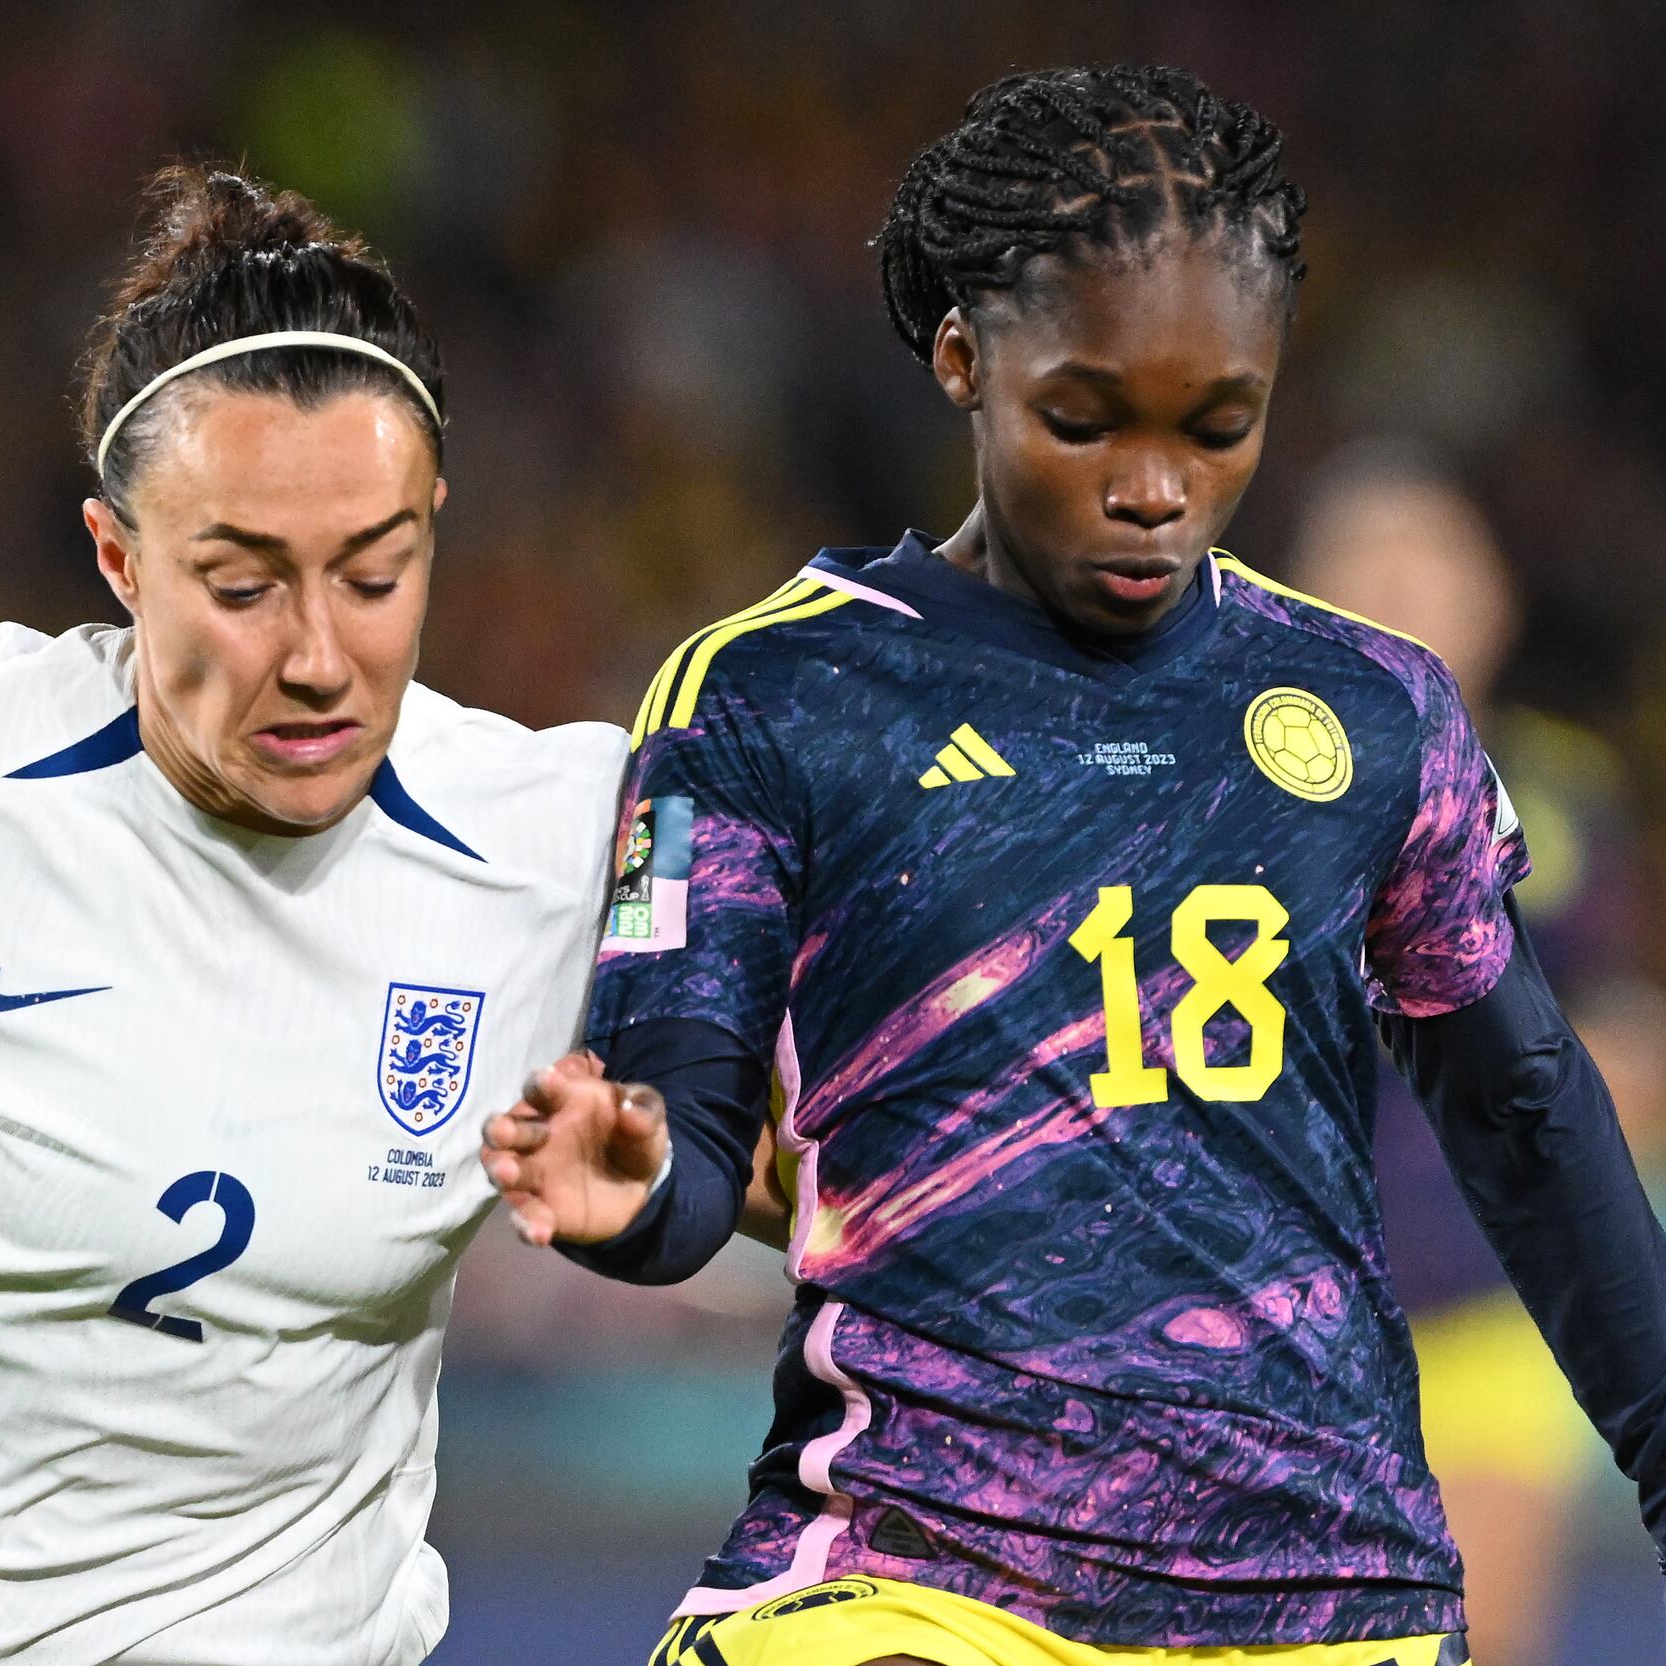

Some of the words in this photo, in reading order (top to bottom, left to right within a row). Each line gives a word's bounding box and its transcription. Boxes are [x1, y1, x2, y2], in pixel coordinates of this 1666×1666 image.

[1094, 742, 1148, 754] ENGLAND
[1077, 753, 1094, 765] 12
[1095, 754, 1141, 765] AUGUST
[1142, 753, 1177, 766] 2023
[1106, 765, 1152, 776] SYDNEY
[1068, 883, 1290, 1109] 18
[387, 1148, 433, 1168] COLOMBIA
[367, 1165, 380, 1182] 12
[382, 1167, 420, 1187] AUGUST
[421, 1171, 446, 1188] 2023
[106, 1170, 256, 1344] 2
